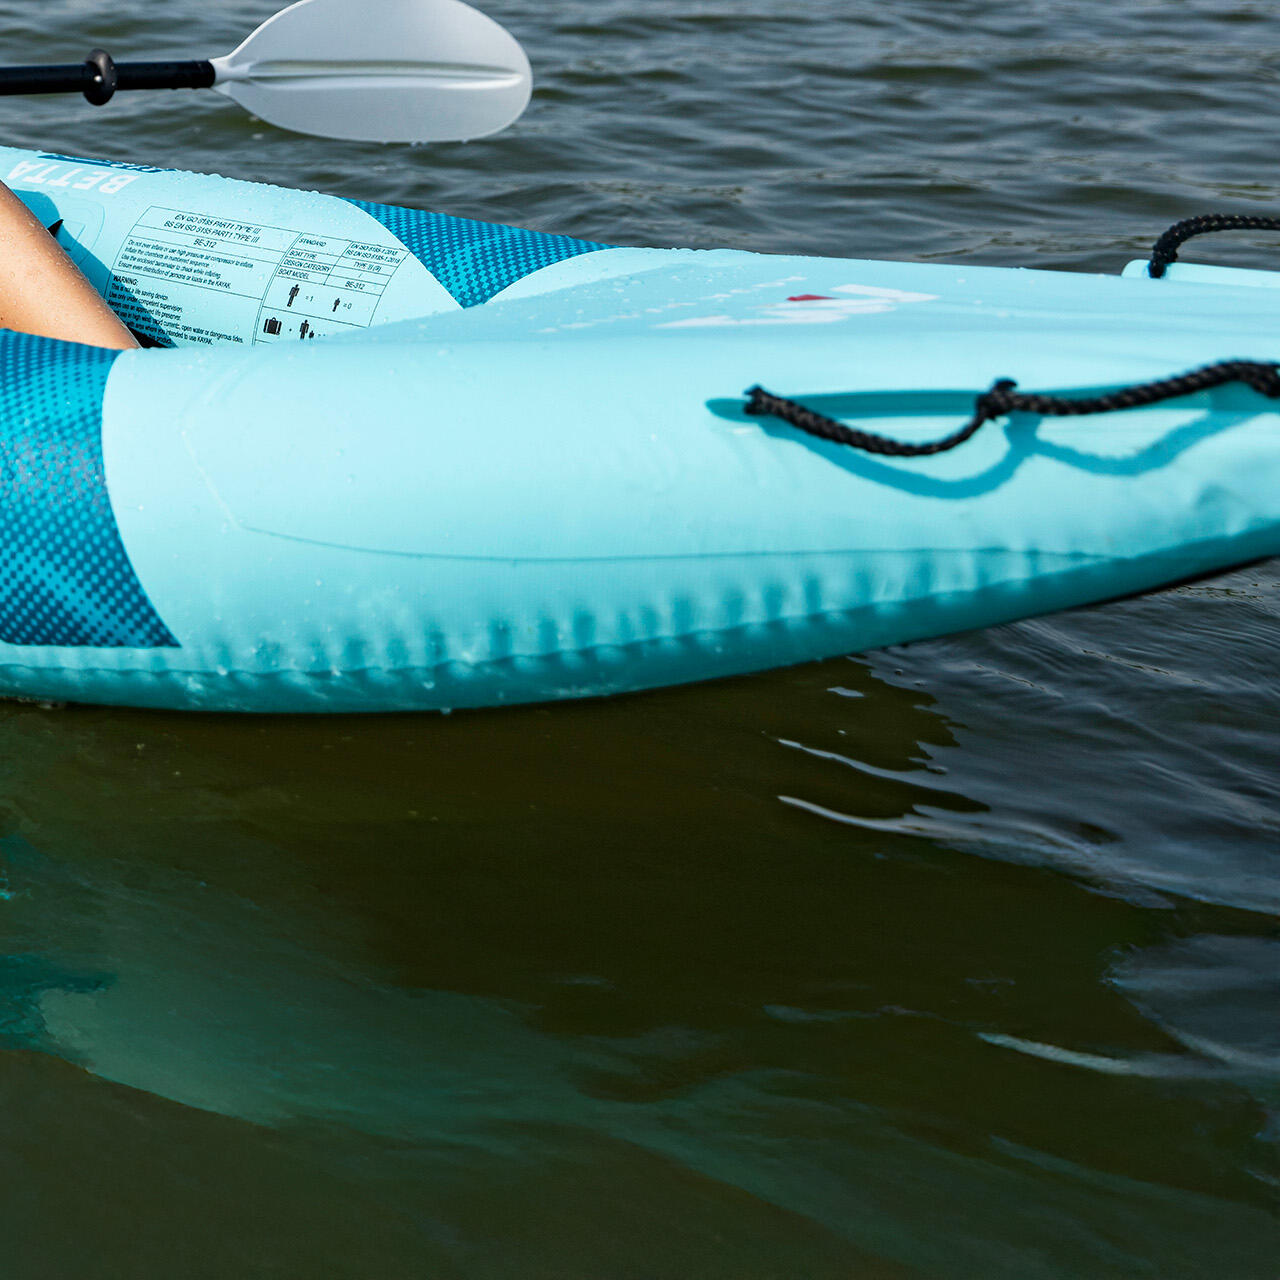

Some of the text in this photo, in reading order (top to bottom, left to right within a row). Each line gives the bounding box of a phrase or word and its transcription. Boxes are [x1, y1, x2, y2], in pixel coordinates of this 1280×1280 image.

[6, 160, 140, 194] BETTA
[193, 238, 217, 248] BE-312
[345, 281, 365, 290] BE-312
